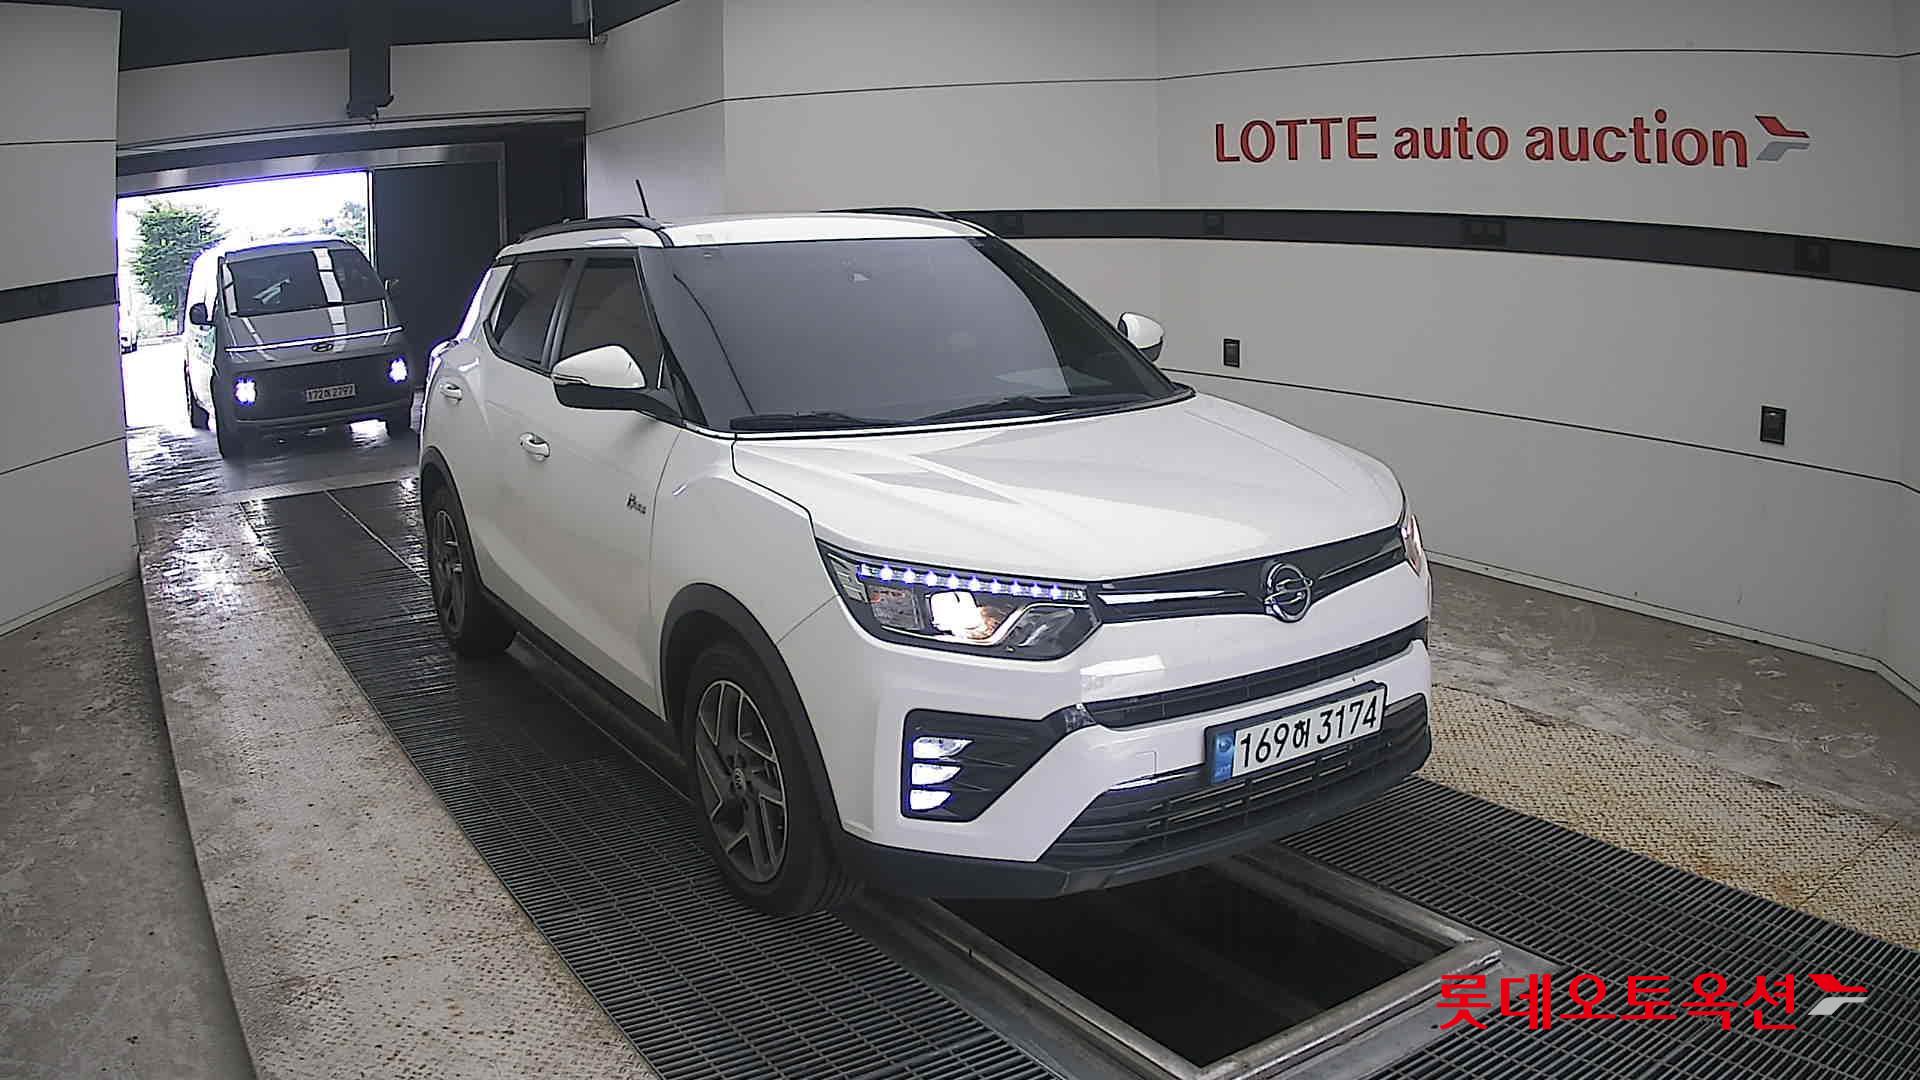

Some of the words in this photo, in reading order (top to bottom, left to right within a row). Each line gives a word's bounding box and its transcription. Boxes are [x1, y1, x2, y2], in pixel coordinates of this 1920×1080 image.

[1215, 115, 1377, 163] LOTTE
[1394, 117, 1508, 161] auto
[1525, 109, 1748, 168] auction
[1240, 718, 1311, 768] 169허
[1317, 695, 1378, 745] 3174
